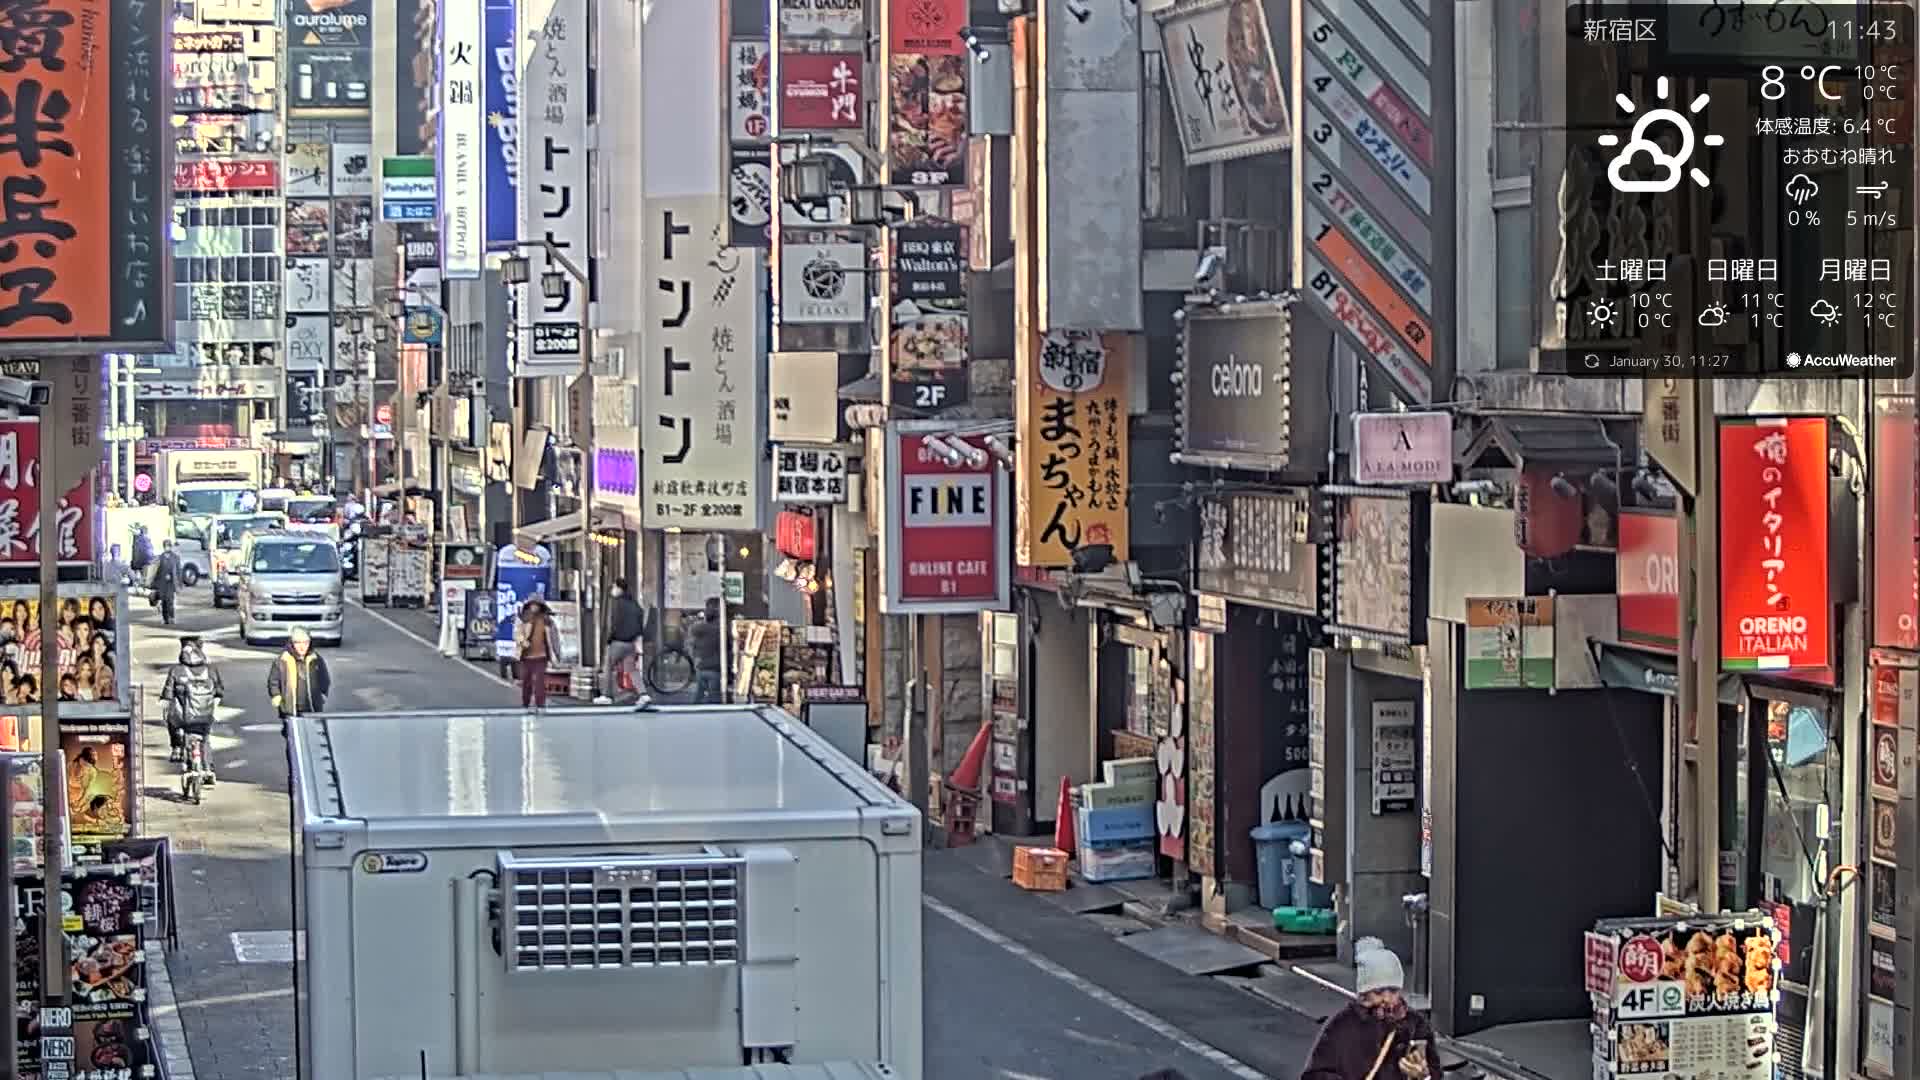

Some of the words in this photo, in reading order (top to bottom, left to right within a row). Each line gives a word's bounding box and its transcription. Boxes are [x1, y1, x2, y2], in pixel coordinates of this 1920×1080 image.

[1313, 24, 1333, 43] 5
[449, 41, 473, 105] 火鍋
[542, 17, 568, 125] 焼とん酒場
[829, 60, 858, 121] 牛門
[1314, 76, 1332, 93] 4
[1355, 119, 1411, 180] センチュリー
[1314, 123, 1332, 143] 3
[385, 183, 434, 194] FamilyMart
[911, 171, 949, 185] 3F
[1313, 174, 1332, 194] 2
[1315, 223, 1331, 241] 1
[900, 256, 958, 273] Walton's
[1311, 270, 1338, 299] B1
[658, 210, 692, 465] トントン
[711, 325, 736, 446] 焼とん酒場
[1211, 353, 1263, 397] celona
[915, 385, 946, 406] 2F
[1039, 397, 1085, 551] まっちゃん
[777, 475, 843, 495] 新宿本店
[910, 485, 986, 515] FINE
[1753, 431, 1789, 606] 俺のイタリアン
[909, 562, 953, 577] ONLINE
[956, 561, 987, 576] CAFE
[1739, 616, 1807, 635] ORENO
[1739, 636, 1808, 653] ITALIAN
[1622, 989, 1654, 1011] 4F
[40, 1007, 72, 1028] NERO
[43, 1040, 73, 1059] NERO
